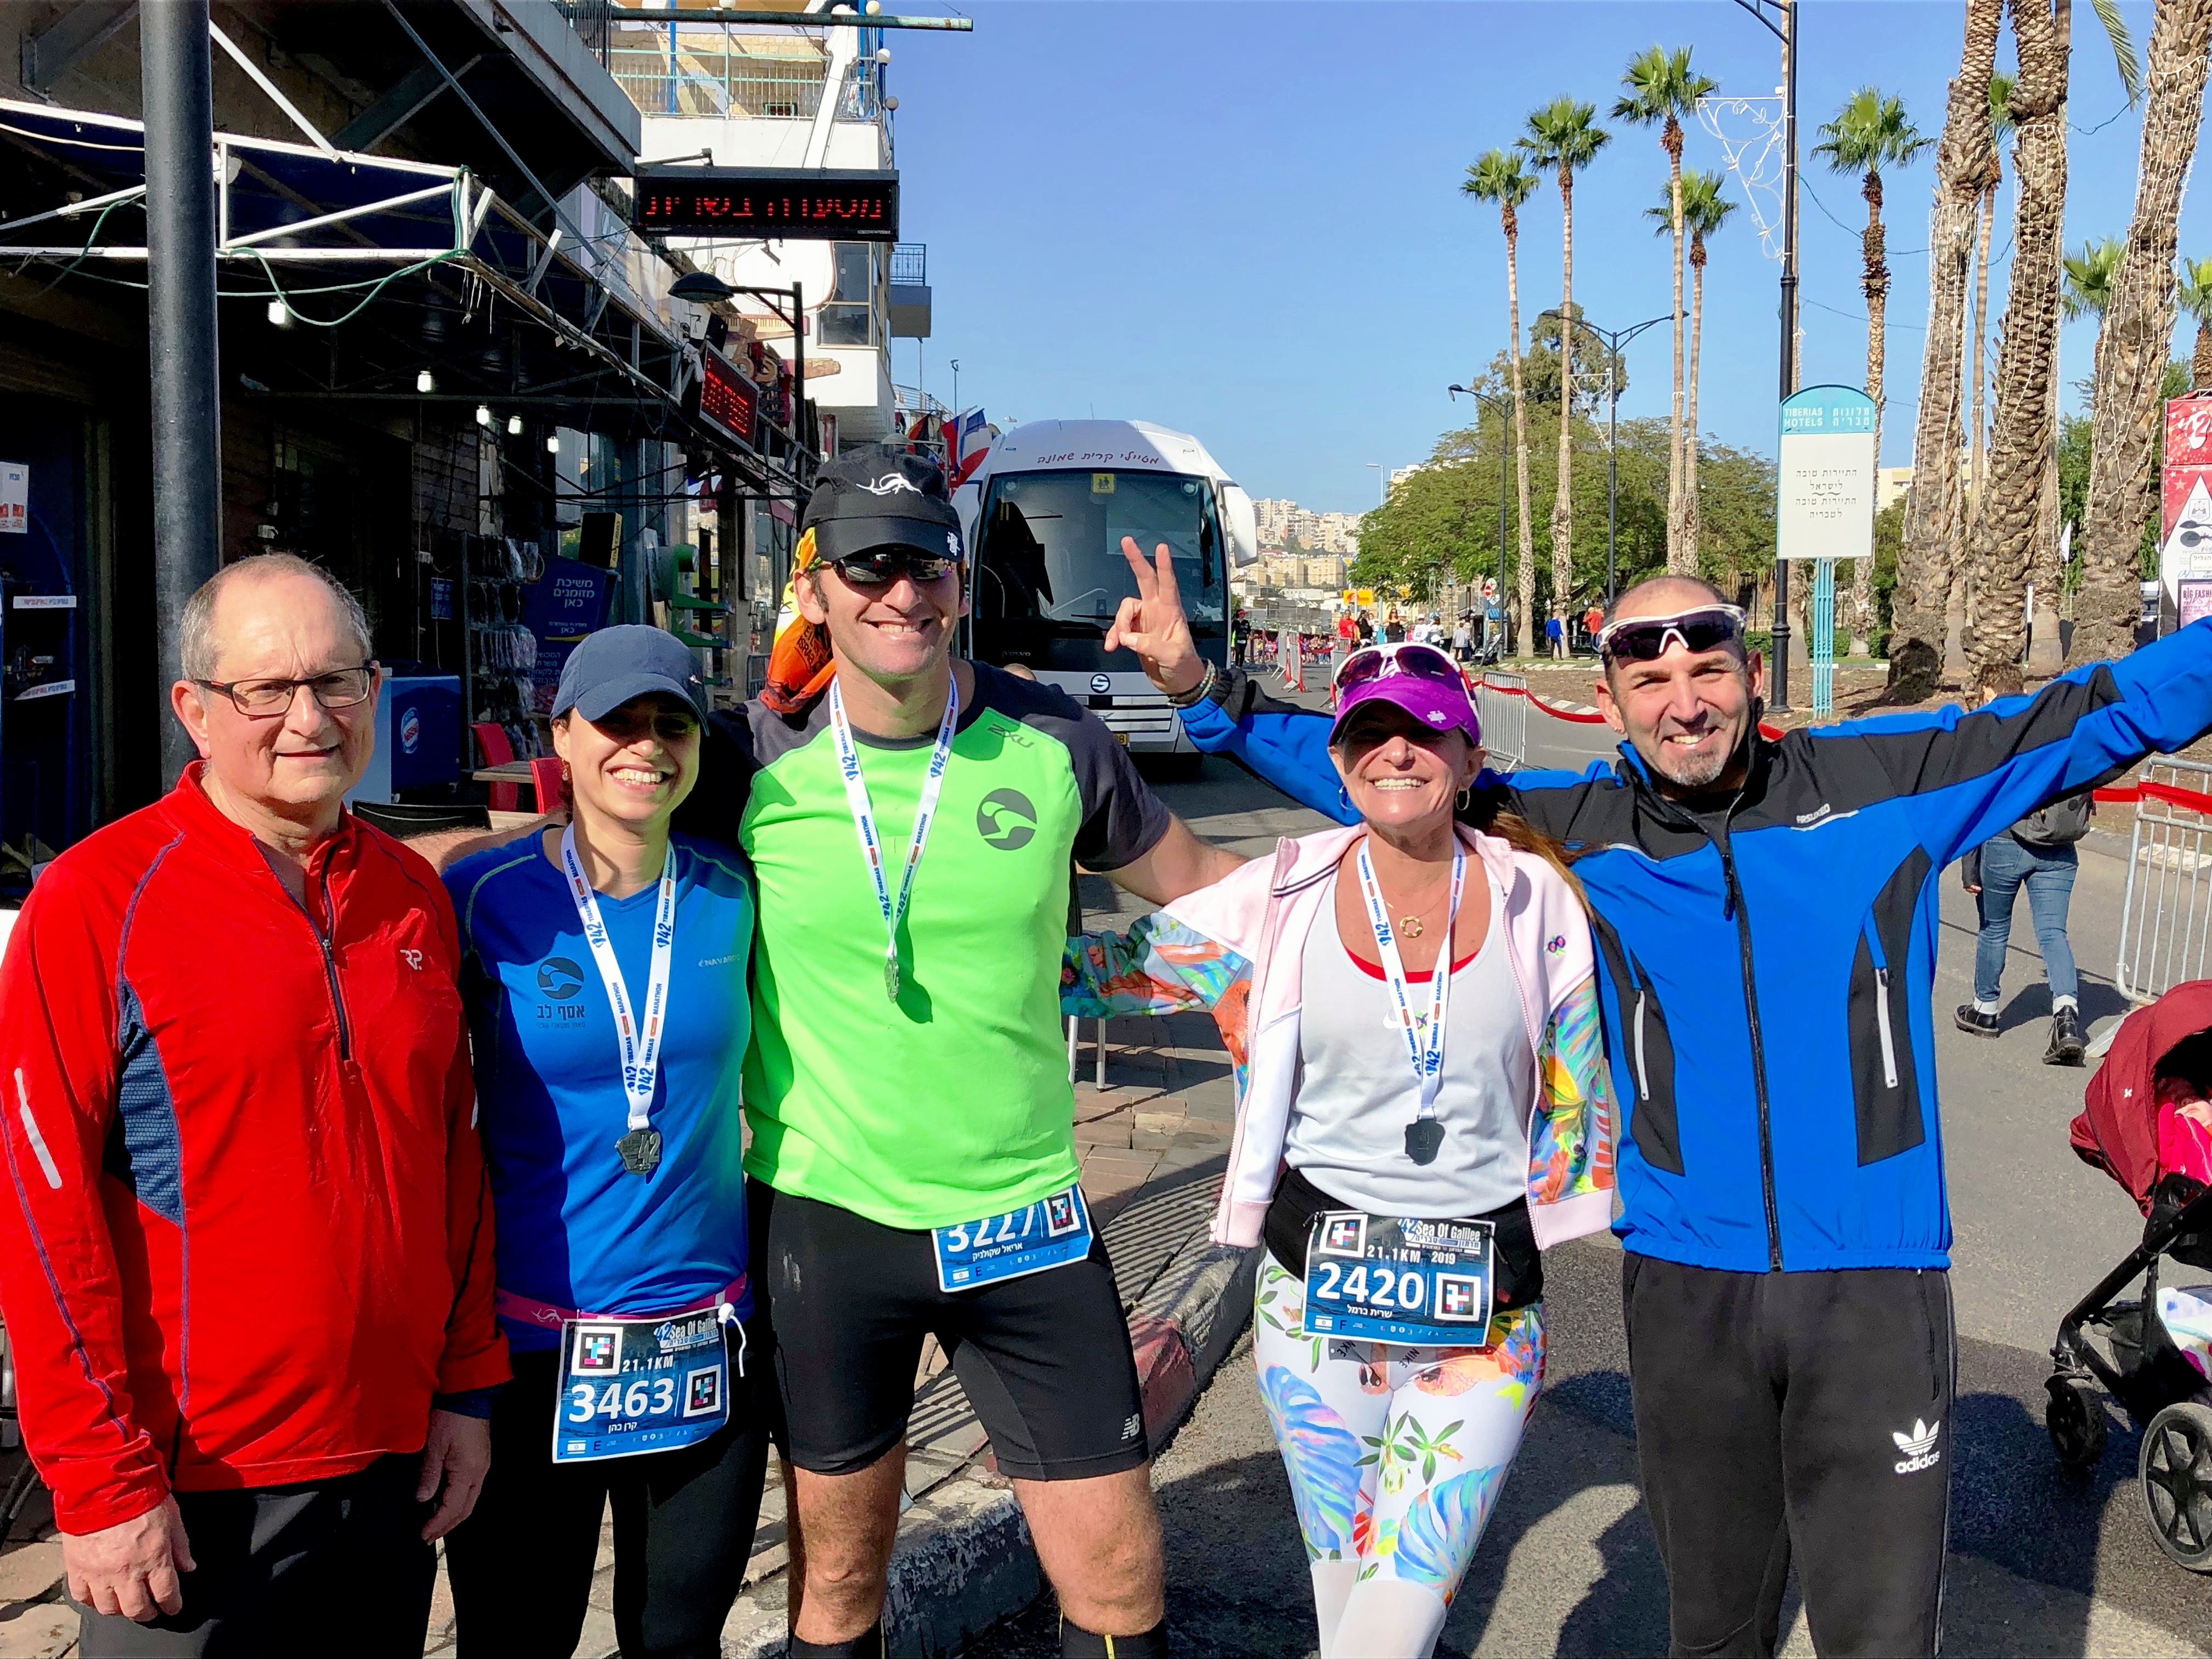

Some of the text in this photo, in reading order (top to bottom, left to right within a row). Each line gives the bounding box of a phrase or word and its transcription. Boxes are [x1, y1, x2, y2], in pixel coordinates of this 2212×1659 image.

[1784, 407, 1823, 417] TIBERIAS
[1784, 417, 1823, 427] HOTELS
[1036, 452, 1075, 465] שמונה
[1080, 452, 1114, 464] קרית
[1796, 469, 1858, 478] התיירות טובה
[1809, 479, 1843, 490] לישראל
[1795, 497, 1857, 506] התיירות טובה
[1809, 508, 1843, 519] לטבריה
[556, 578, 594, 588] משיכת
[553, 588, 595, 598] מזומנים
[564, 599, 584, 608] כאן
[861, 815, 874, 846] MARATHON
[612, 982, 626, 1014] MARATHON
[537, 1003, 585, 1021] אסף לב
[645, 1038, 655, 1066] TIBERIAS
[653, 983, 662, 1015] MARATHON
[625, 1036, 635, 1064] TIBERIAS
[1415, 1220, 1435, 1238] Sea
[1437, 1222, 1450, 1238] Of
[1451, 1225, 1481, 1242] Galilee
[1001, 1242, 1023, 1254] אריאל
[972, 1248, 1001, 1262] שקולניק
[1431, 1251, 1456, 1265] 2019
[975, 1266, 983, 1277] E
[1316, 1262, 1425, 1310] 2420
[1346, 1304, 1393, 1319] שרית כרמל
[669, 1324, 686, 1339] Sea
[687, 1320, 696, 1336] Of
[697, 1317, 716, 1334] Galilee
[1339, 1319, 1347, 1330] F
[622, 1355, 674, 1373] 21.1KM
[1398, 1347, 1420, 1369] NIKE
[568, 1378, 675, 1423] 3463
[608, 1421, 637, 1434] קרן כהן
[593, 1440, 602, 1452] E
[1894, 1450, 1941, 1475] adidas
